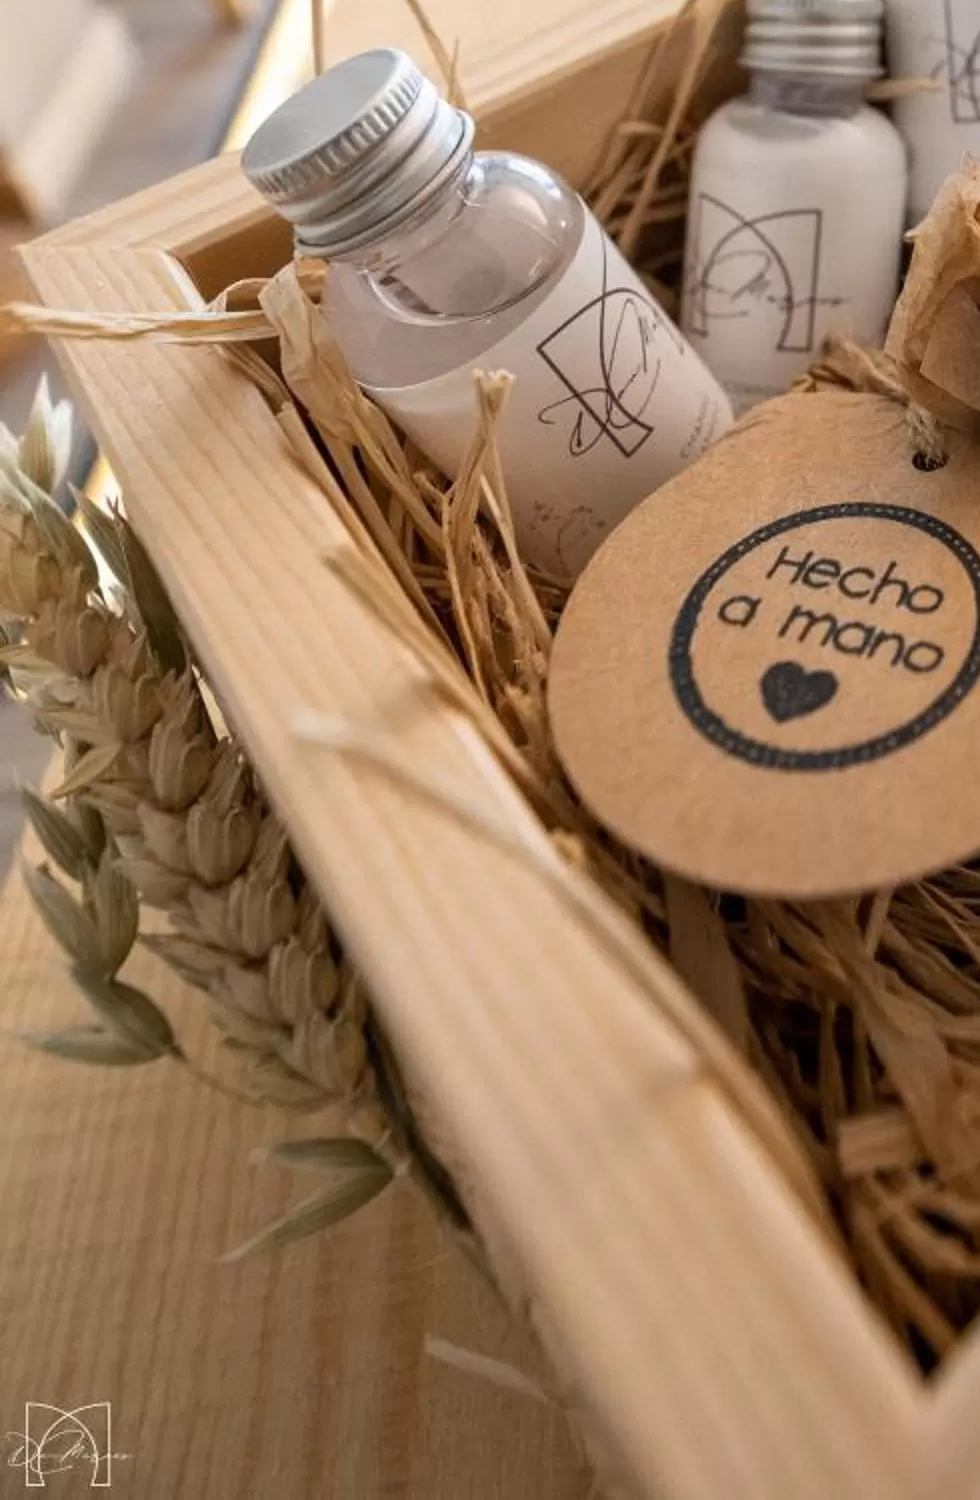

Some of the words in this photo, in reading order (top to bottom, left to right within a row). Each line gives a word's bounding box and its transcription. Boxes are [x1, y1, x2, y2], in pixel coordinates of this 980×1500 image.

[766, 546, 945, 614] Hecho
[718, 595, 762, 628] a
[778, 605, 945, 674] mano
